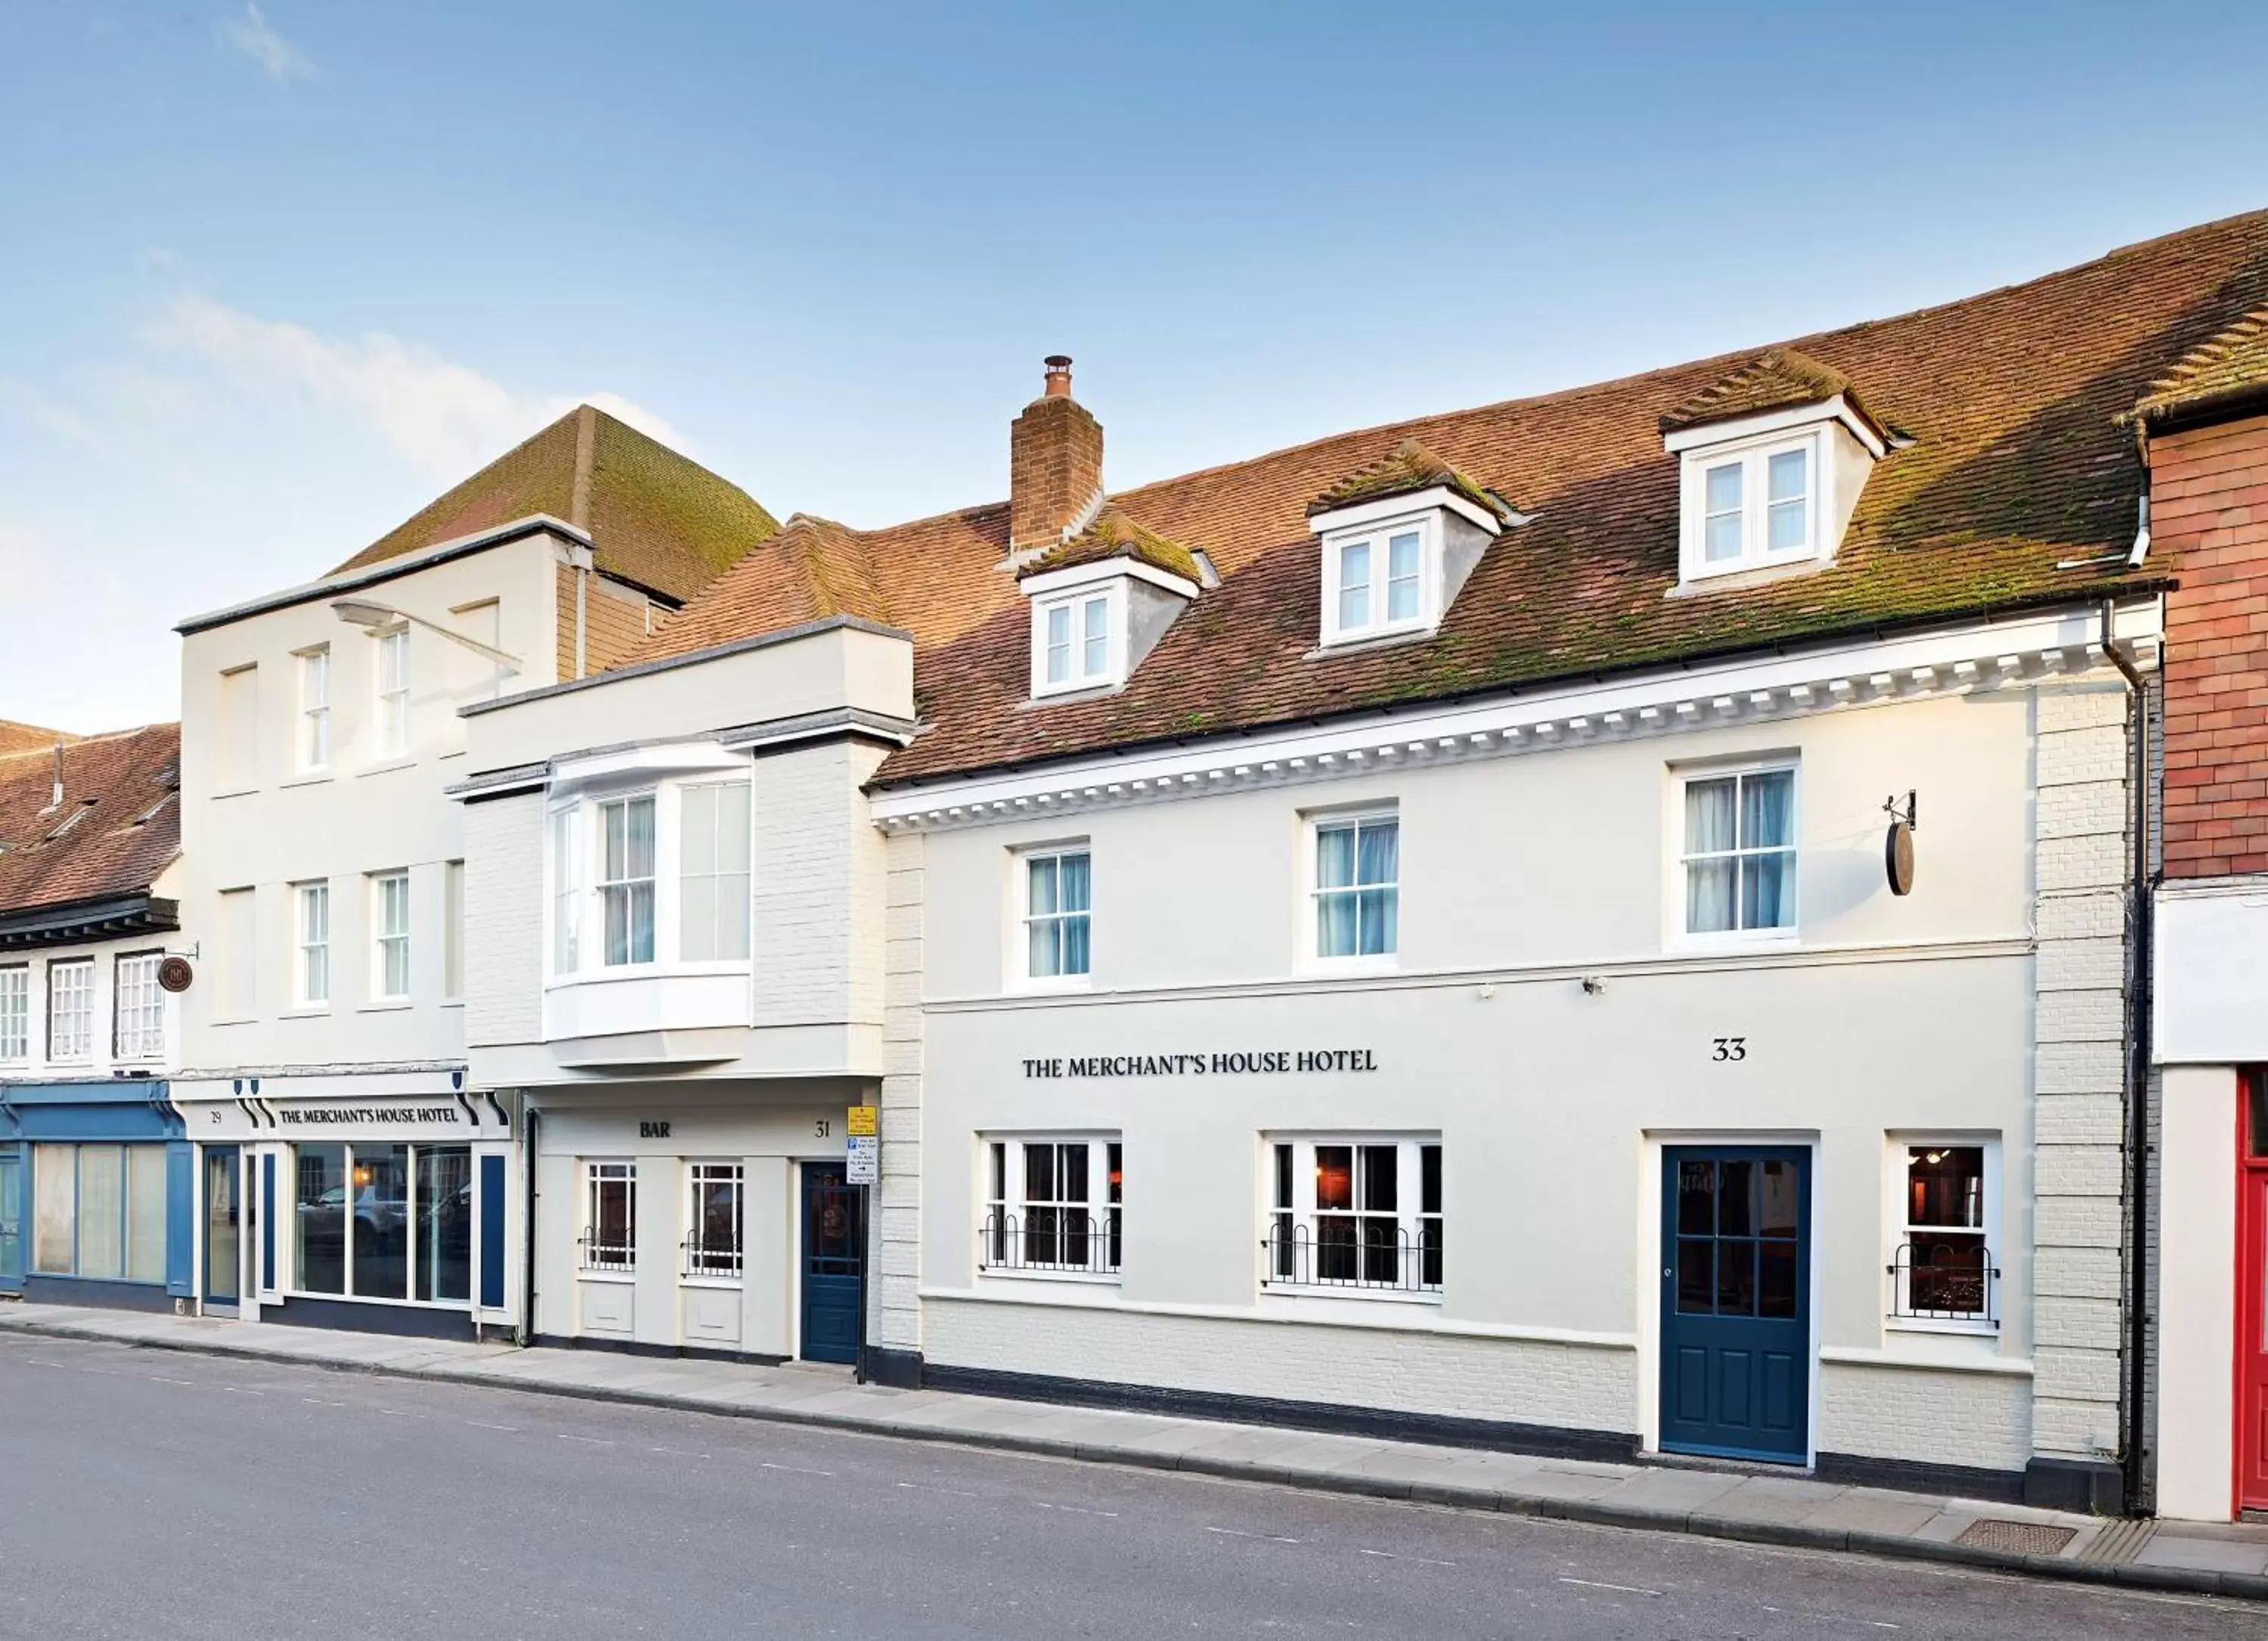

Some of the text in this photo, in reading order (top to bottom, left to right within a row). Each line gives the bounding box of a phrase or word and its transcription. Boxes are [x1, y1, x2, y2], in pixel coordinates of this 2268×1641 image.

[1712, 1037, 1746, 1061] 33
[1023, 1050, 1377, 1078] THE MERCHANT'S HOUSE HOTEL
[211, 1111, 222, 1124] 29
[280, 1108, 459, 1124] THE MERCHANT'S HOUSE HOTEL
[640, 1121, 671, 1138] BAR
[814, 1121, 829, 1137] 31
